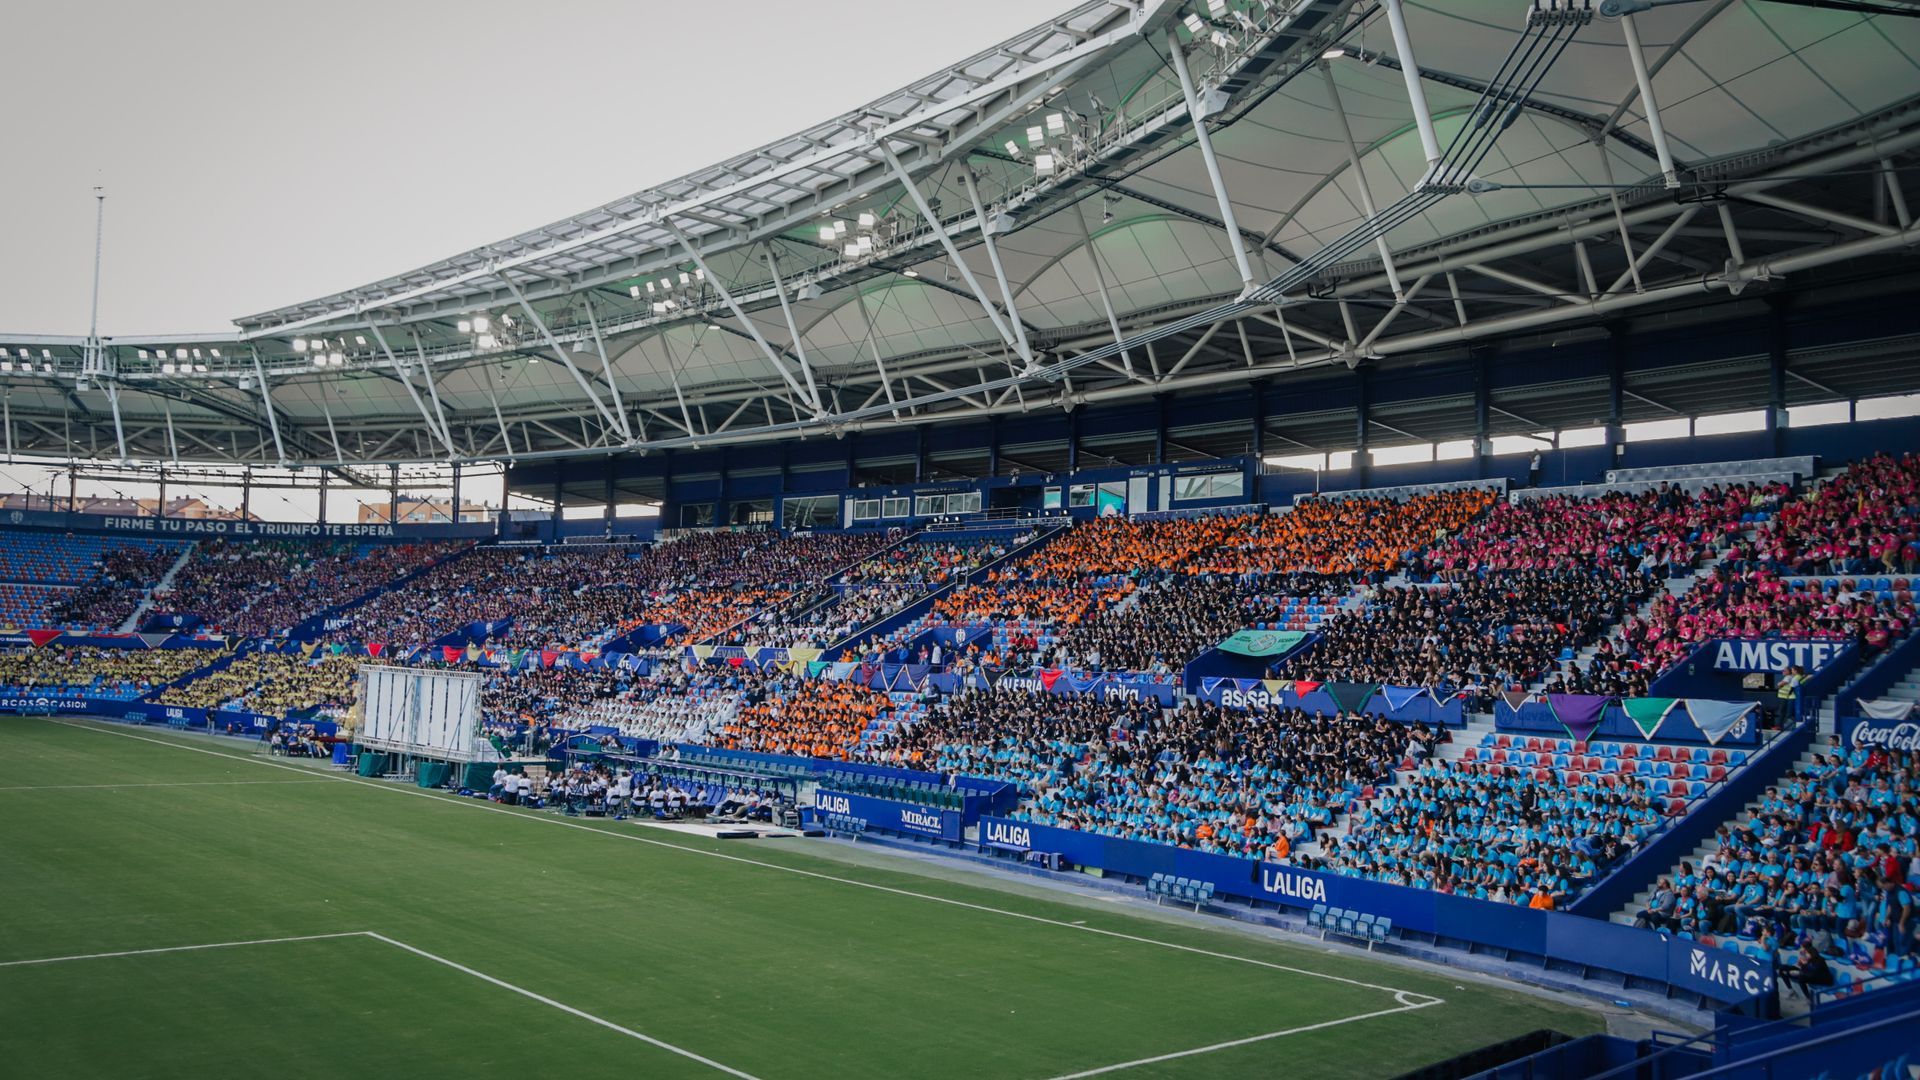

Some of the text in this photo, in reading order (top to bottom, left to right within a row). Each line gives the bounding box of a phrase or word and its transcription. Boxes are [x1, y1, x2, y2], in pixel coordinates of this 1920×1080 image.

[1606, 472, 1617, 484] 9
[104, 517, 394, 536] FIRME TU PASO EL TRIUNFO TE ESPERA
[816, 793, 850, 814] LALIGA
[901, 809, 942, 830] MIRACL
[987, 822, 1031, 847] LALIGA
[1263, 869, 1326, 902] LALIGA
